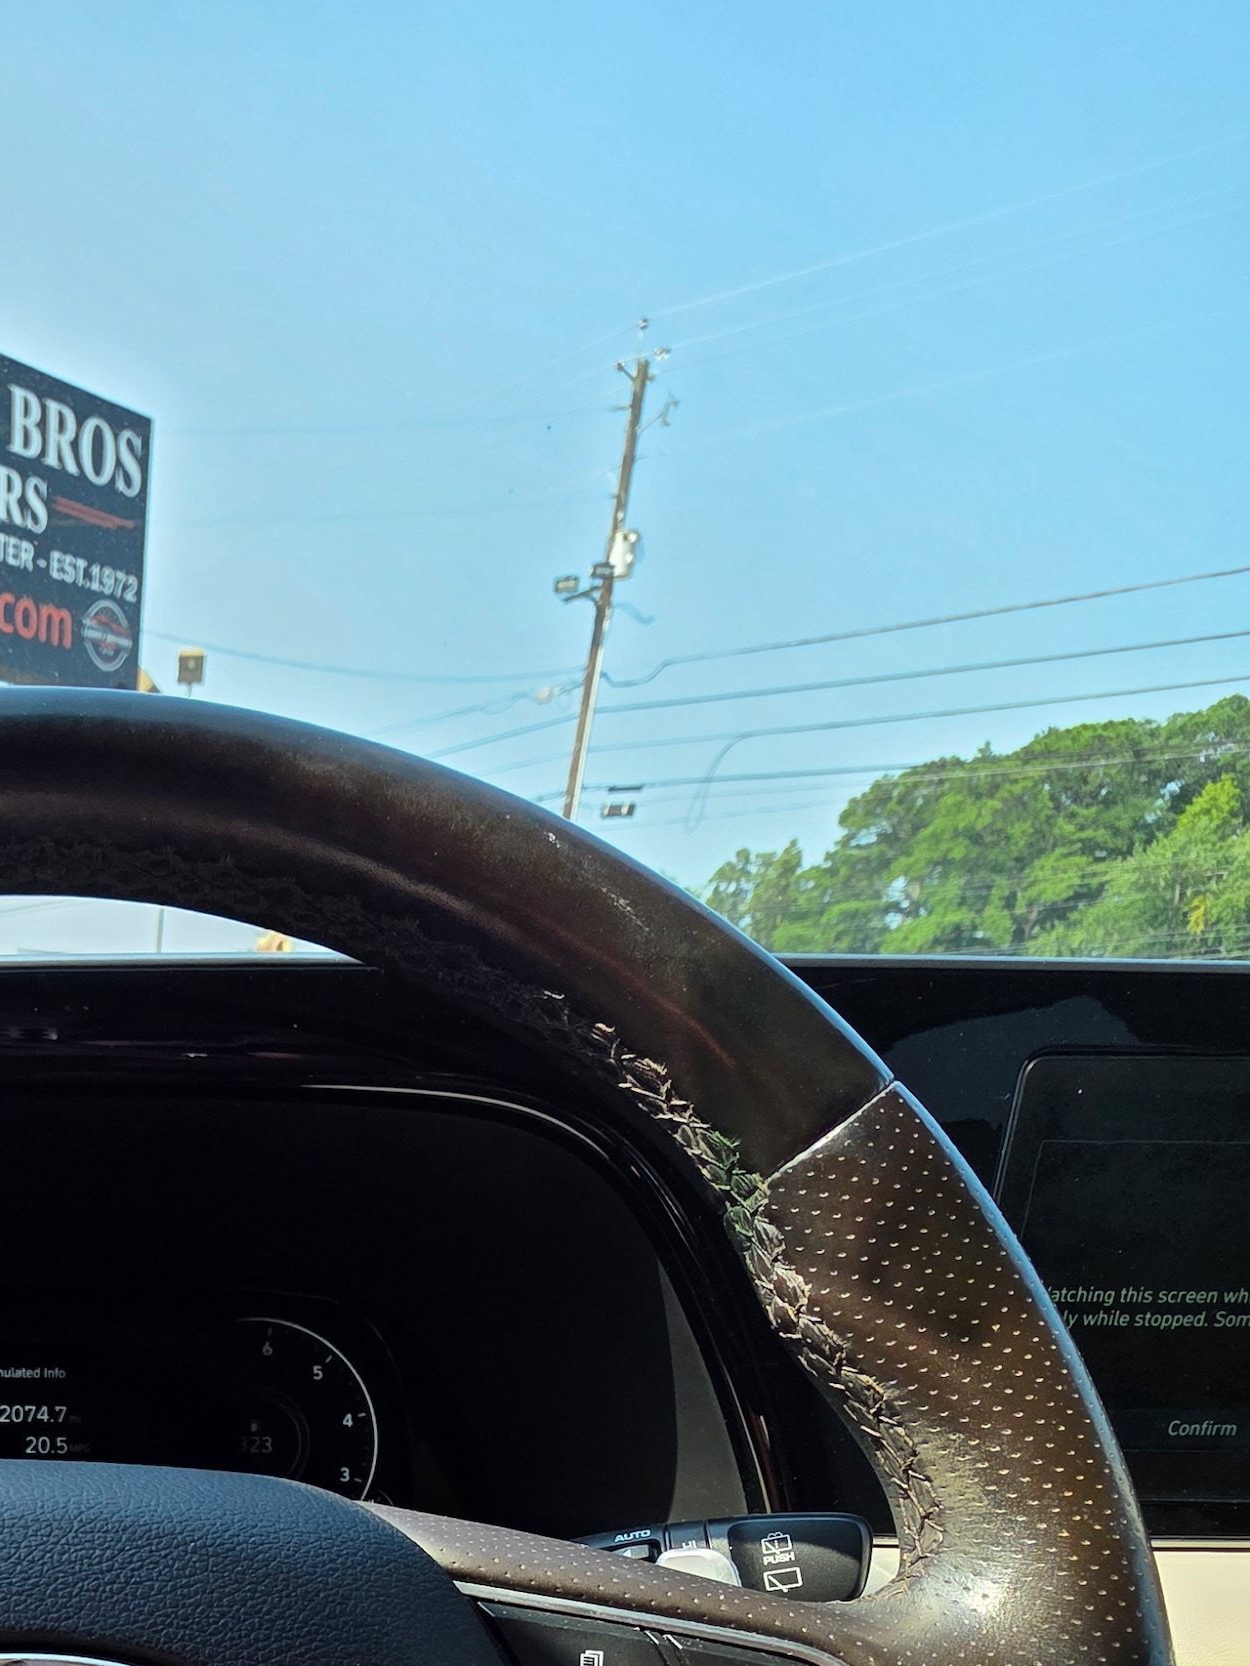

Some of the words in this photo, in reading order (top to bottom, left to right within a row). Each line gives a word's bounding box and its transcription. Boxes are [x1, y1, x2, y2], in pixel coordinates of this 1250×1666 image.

[7, 383, 143, 498] BROS
[1047, 1286, 1115, 1306] atching
[1120, 1286, 1153, 1304] this
[1157, 1290, 1218, 1304] screen
[1083, 1311, 1130, 1327] while
[1134, 1311, 1209, 1330] stopped.
[262, 1341, 273, 1356] 6
[44, 1367, 66, 1378] Info
[312, 1365, 323, 1380] 5
[0, 1405, 67, 1423] 2074.7
[342, 1413, 354, 1428] 4
[1167, 1420, 1237, 1436] Confirm
[25, 1436, 68, 1454] 20.5
[339, 1466, 350, 1482] 3
[614, 1529, 651, 1543] AUTO
[763, 1551, 795, 1566] PUSH
